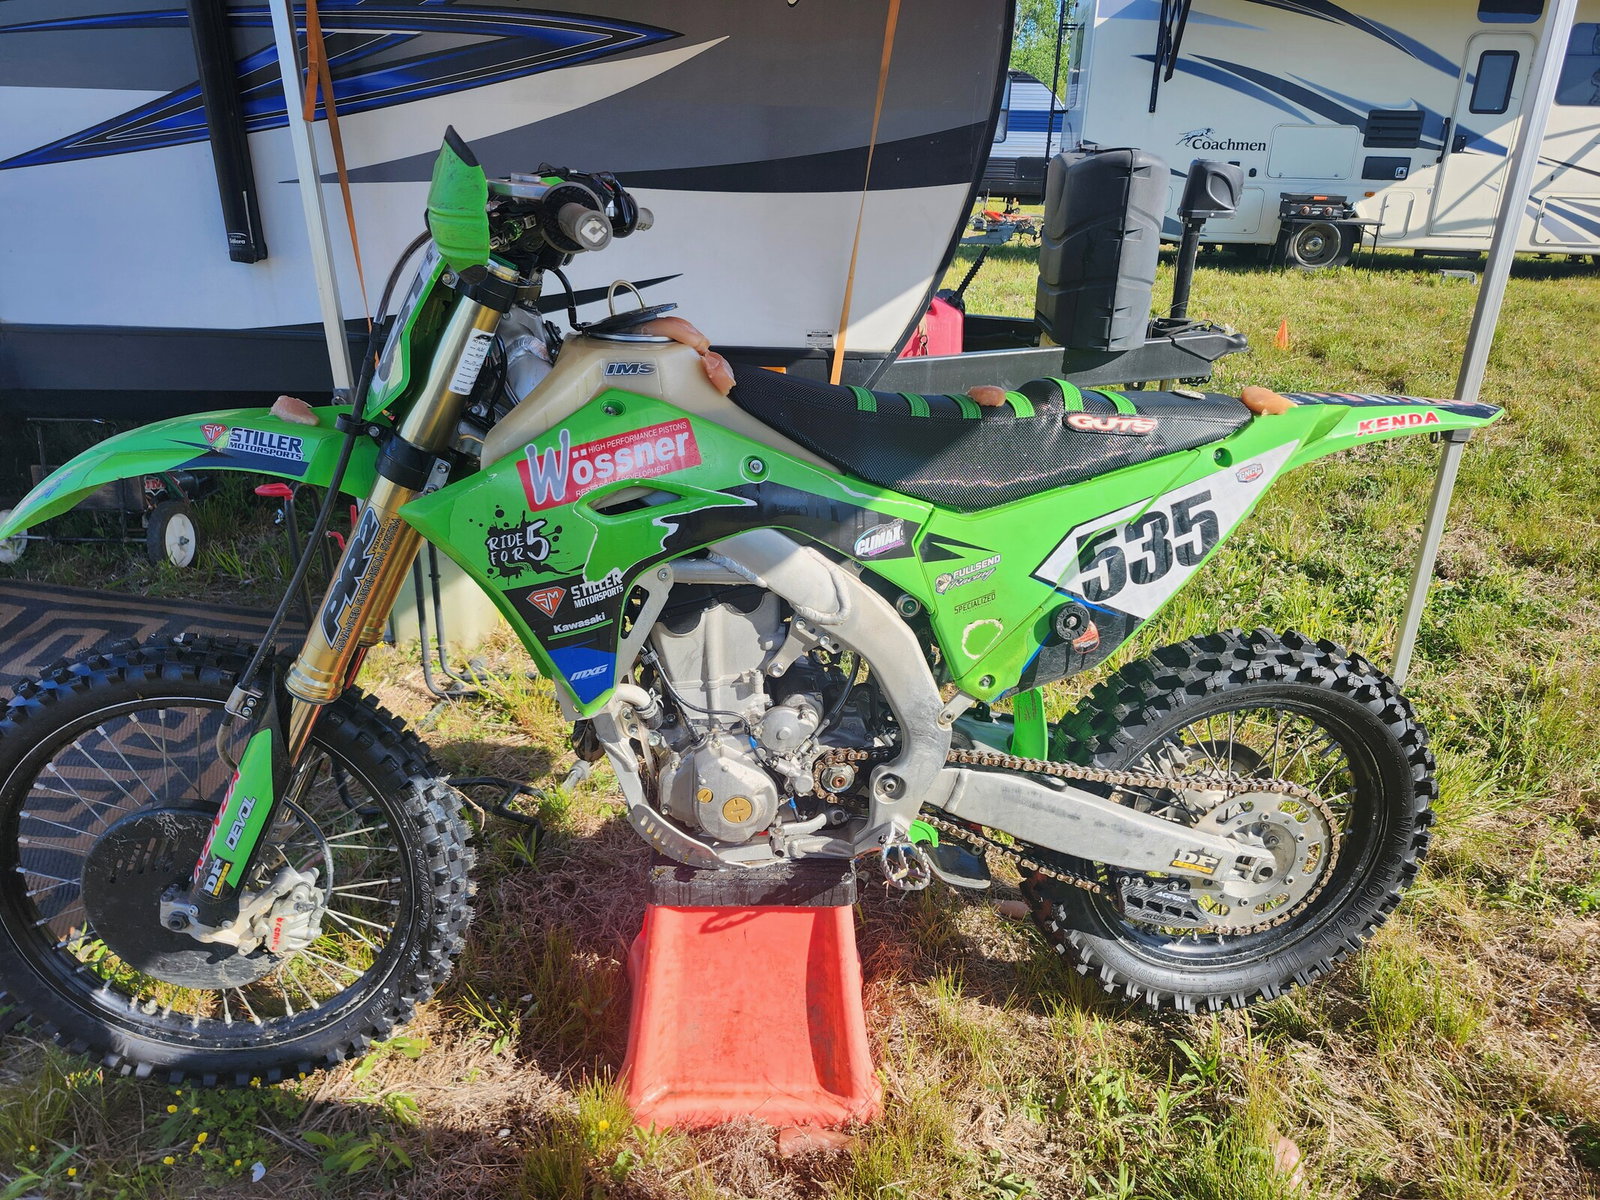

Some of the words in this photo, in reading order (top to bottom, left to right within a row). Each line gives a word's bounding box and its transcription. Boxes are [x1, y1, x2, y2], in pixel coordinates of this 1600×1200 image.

[1192, 138, 1267, 151] Coachmen
[605, 361, 657, 376] IMS
[1066, 413, 1159, 434] GUTS
[1356, 411, 1441, 436] KENDA
[228, 441, 304, 461] MOTORSPORTS
[229, 427, 303, 454] STILLER
[588, 442, 606, 454] HIGH
[606, 430, 658, 450] PERFORMANCE
[657, 421, 688, 437] PISTONS
[524, 428, 689, 505] Wössner
[486, 532, 525, 551] RIDE
[526, 518, 550, 561] 5
[856, 525, 903, 556] CLIMAX
[1075, 489, 1220, 603] 535
[490, 547, 525, 565] FOR
[952, 553, 1002, 580] FULLSEND
[320, 506, 381, 649] PR2
[335, 605, 361, 653] ADVANCED
[355, 551, 387, 607] SUSPENSION
[381, 517, 402, 555] SYSTEM
[570, 571, 623, 600] STILLER
[573, 583, 625, 609] MOTORSPORTS
[953, 592, 997, 615] SPECIALIZED
[553, 611, 607, 634] Kawasaki
[223, 795, 257, 852] DEVOL
[1176, 849, 1219, 870] DP
[203, 857, 223, 895] DP
